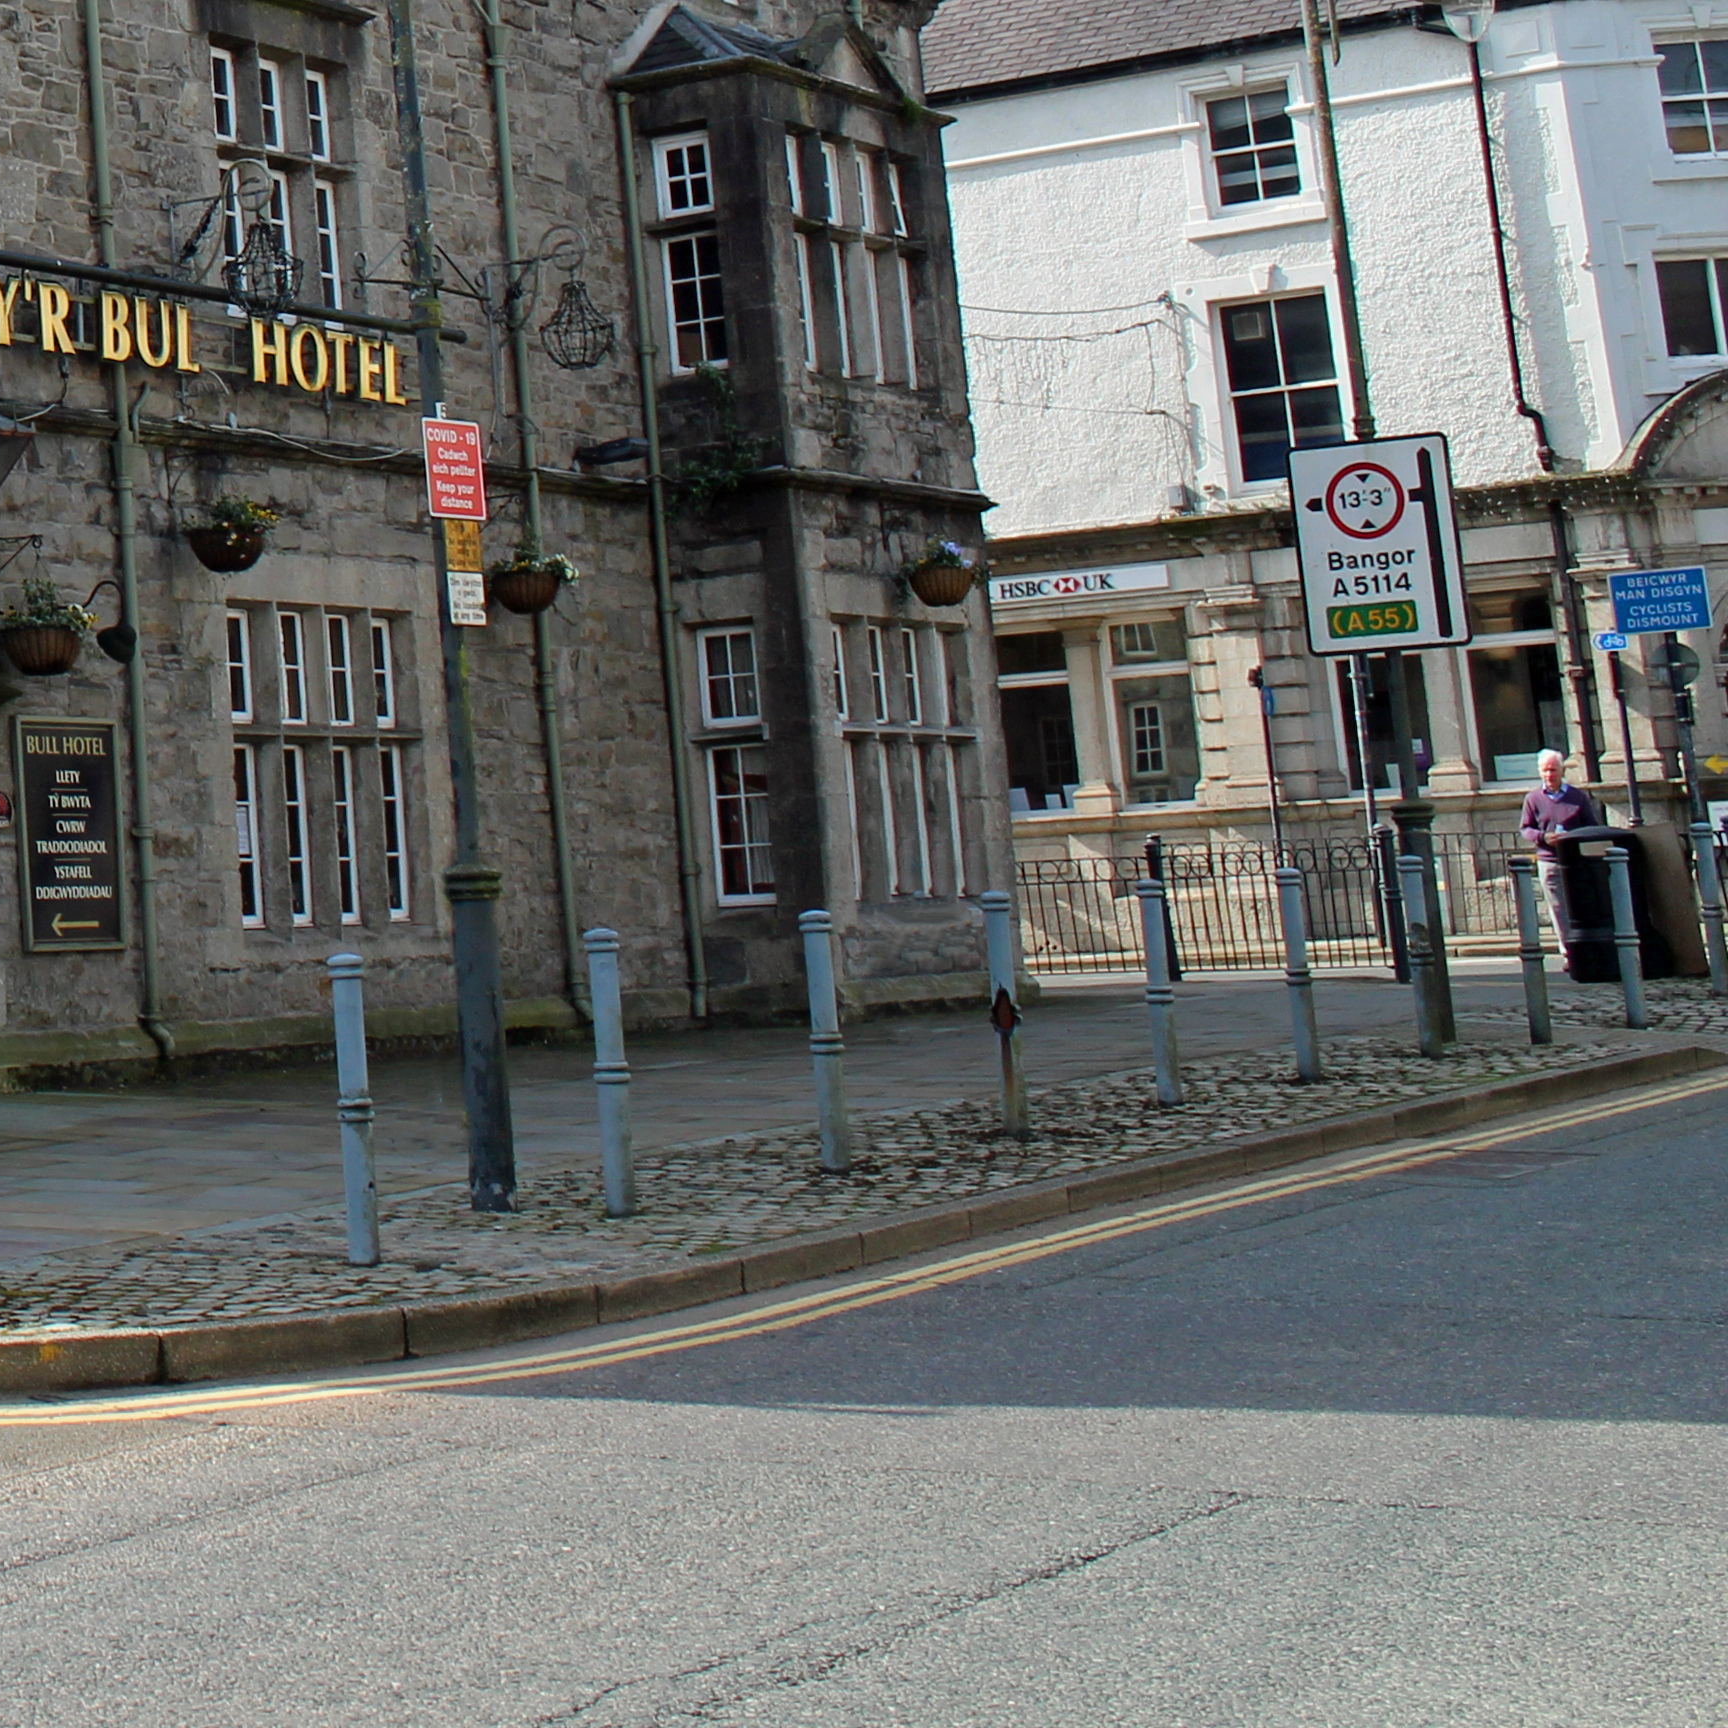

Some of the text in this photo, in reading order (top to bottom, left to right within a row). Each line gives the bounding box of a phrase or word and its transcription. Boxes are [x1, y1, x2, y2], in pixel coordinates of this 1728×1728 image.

[100, 288, 201, 374] BUL
[251, 317, 407, 407] HOTEL
[427, 427, 458, 443] COVID
[465, 432, 476, 446] 19
[436, 480, 475, 496] Keep your
[441, 495, 474, 510] distance
[1327, 548, 1416, 571] Bangor
[999, 573, 1116, 599] HSBC UK
[1626, 573, 1687, 588] BEICWYR
[1615, 584, 1703, 601] MAN DISGYN
[1629, 601, 1693, 616] CYCLISTS
[1627, 613, 1700, 628] DISMOUNT
[26, 735, 106, 756] BULL HOTEL
[55, 770, 80, 784] LLETY
[61, 794, 91, 809] BWYTA
[56, 820, 86, 834] CWRW
[36, 839, 107, 854] TRADDODIADOL
[54, 865, 92, 879] YSTAFELL
[36, 885, 112, 900] DDIGWYDDIADAU
